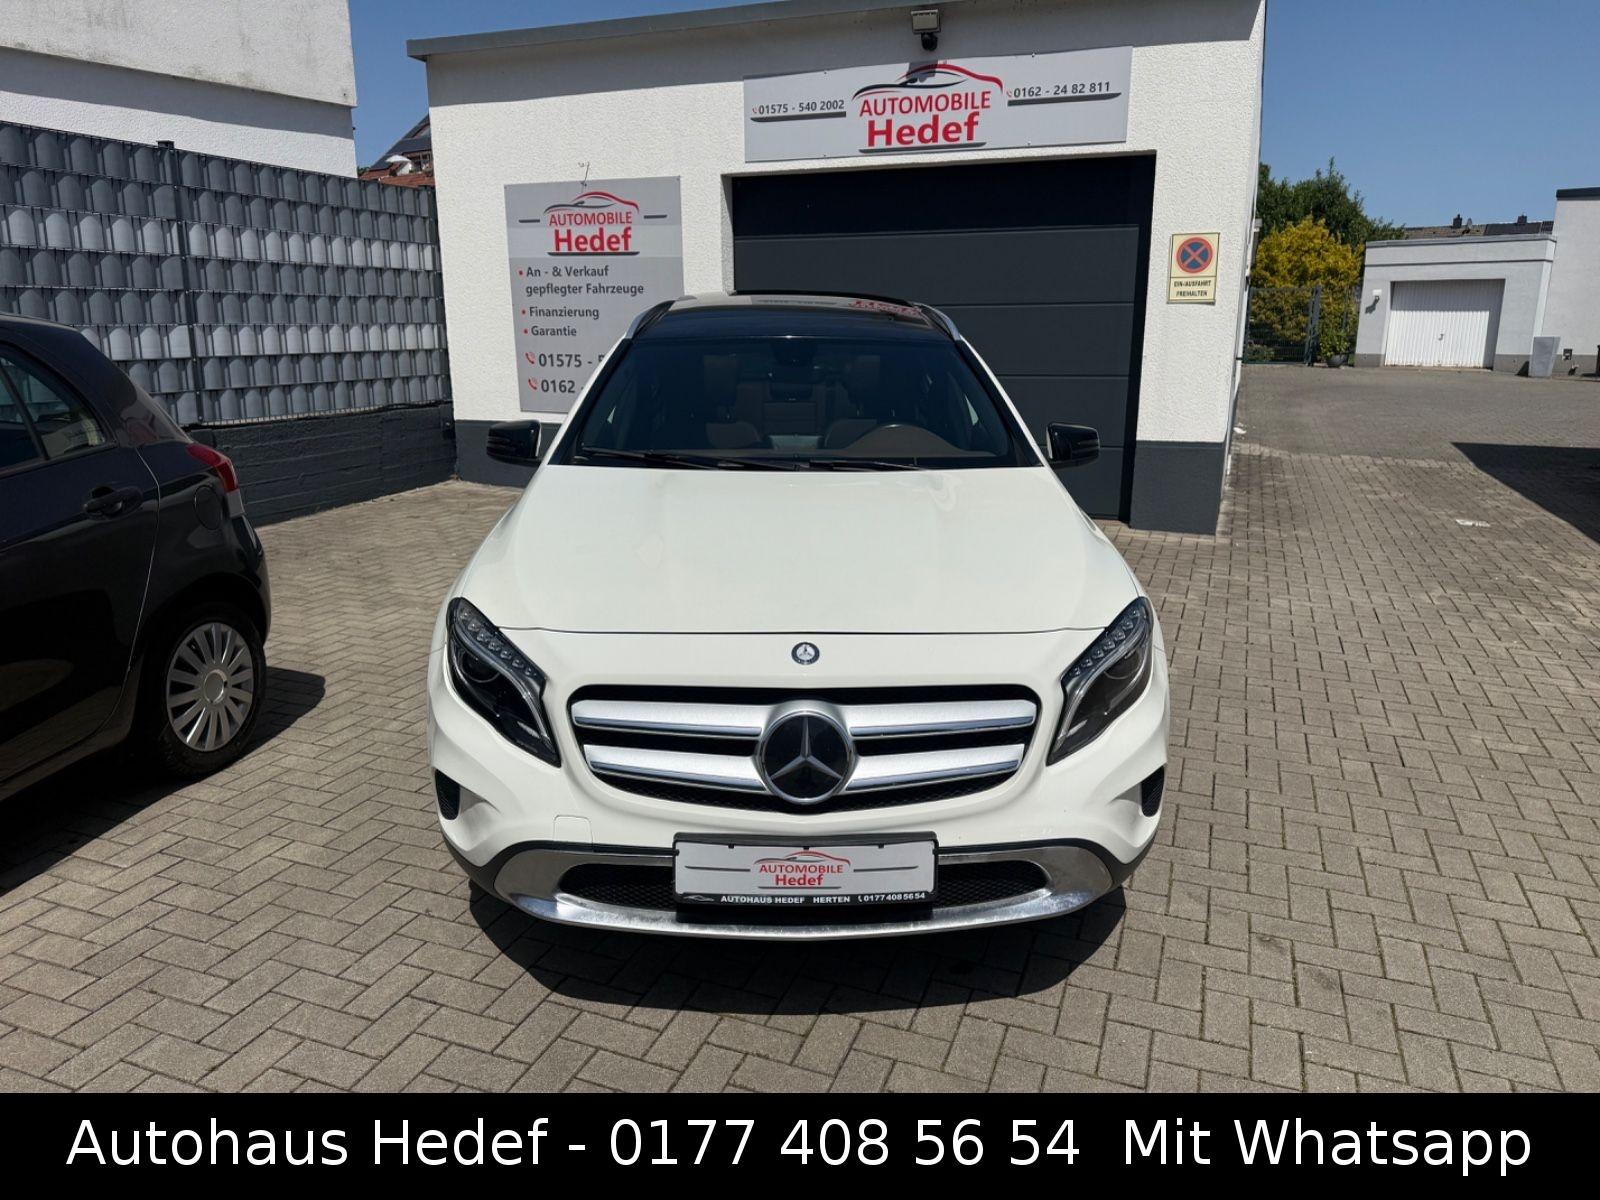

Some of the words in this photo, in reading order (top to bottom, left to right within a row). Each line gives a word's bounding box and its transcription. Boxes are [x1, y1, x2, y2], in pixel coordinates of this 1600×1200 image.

[1013, 86, 1042, 99] 0162
[1053, 84, 1067, 96] 24
[1071, 83, 1085, 95] 82
[1089, 81, 1110, 93] 811
[758, 103, 788, 115] 01575
[798, 101, 817, 112] 540
[820, 99, 845, 111] 2002
[859, 90, 992, 117] AUTOMOBILE
[867, 111, 980, 147] Hedef
[549, 211, 632, 226] AUTOMOBILE
[554, 226, 632, 252] Hedef
[526, 267, 541, 277] An
[552, 267, 562, 277] &
[564, 265, 609, 277] Verkauf
[526, 283, 582, 297] gepflegter
[586, 283, 644, 296] Fahrzeuge
[529, 306, 600, 320] Finanzierung
[531, 326, 577, 336] Garantie
[538, 353, 582, 368] 01575
[541, 380, 575, 393] 0162
[759, 864, 844, 874] AUTOMOBILE
[775, 874, 824, 886] Hedef
[720, 896, 773, 904] AUTOHAUS
[813, 896, 850, 904] HERTEN
